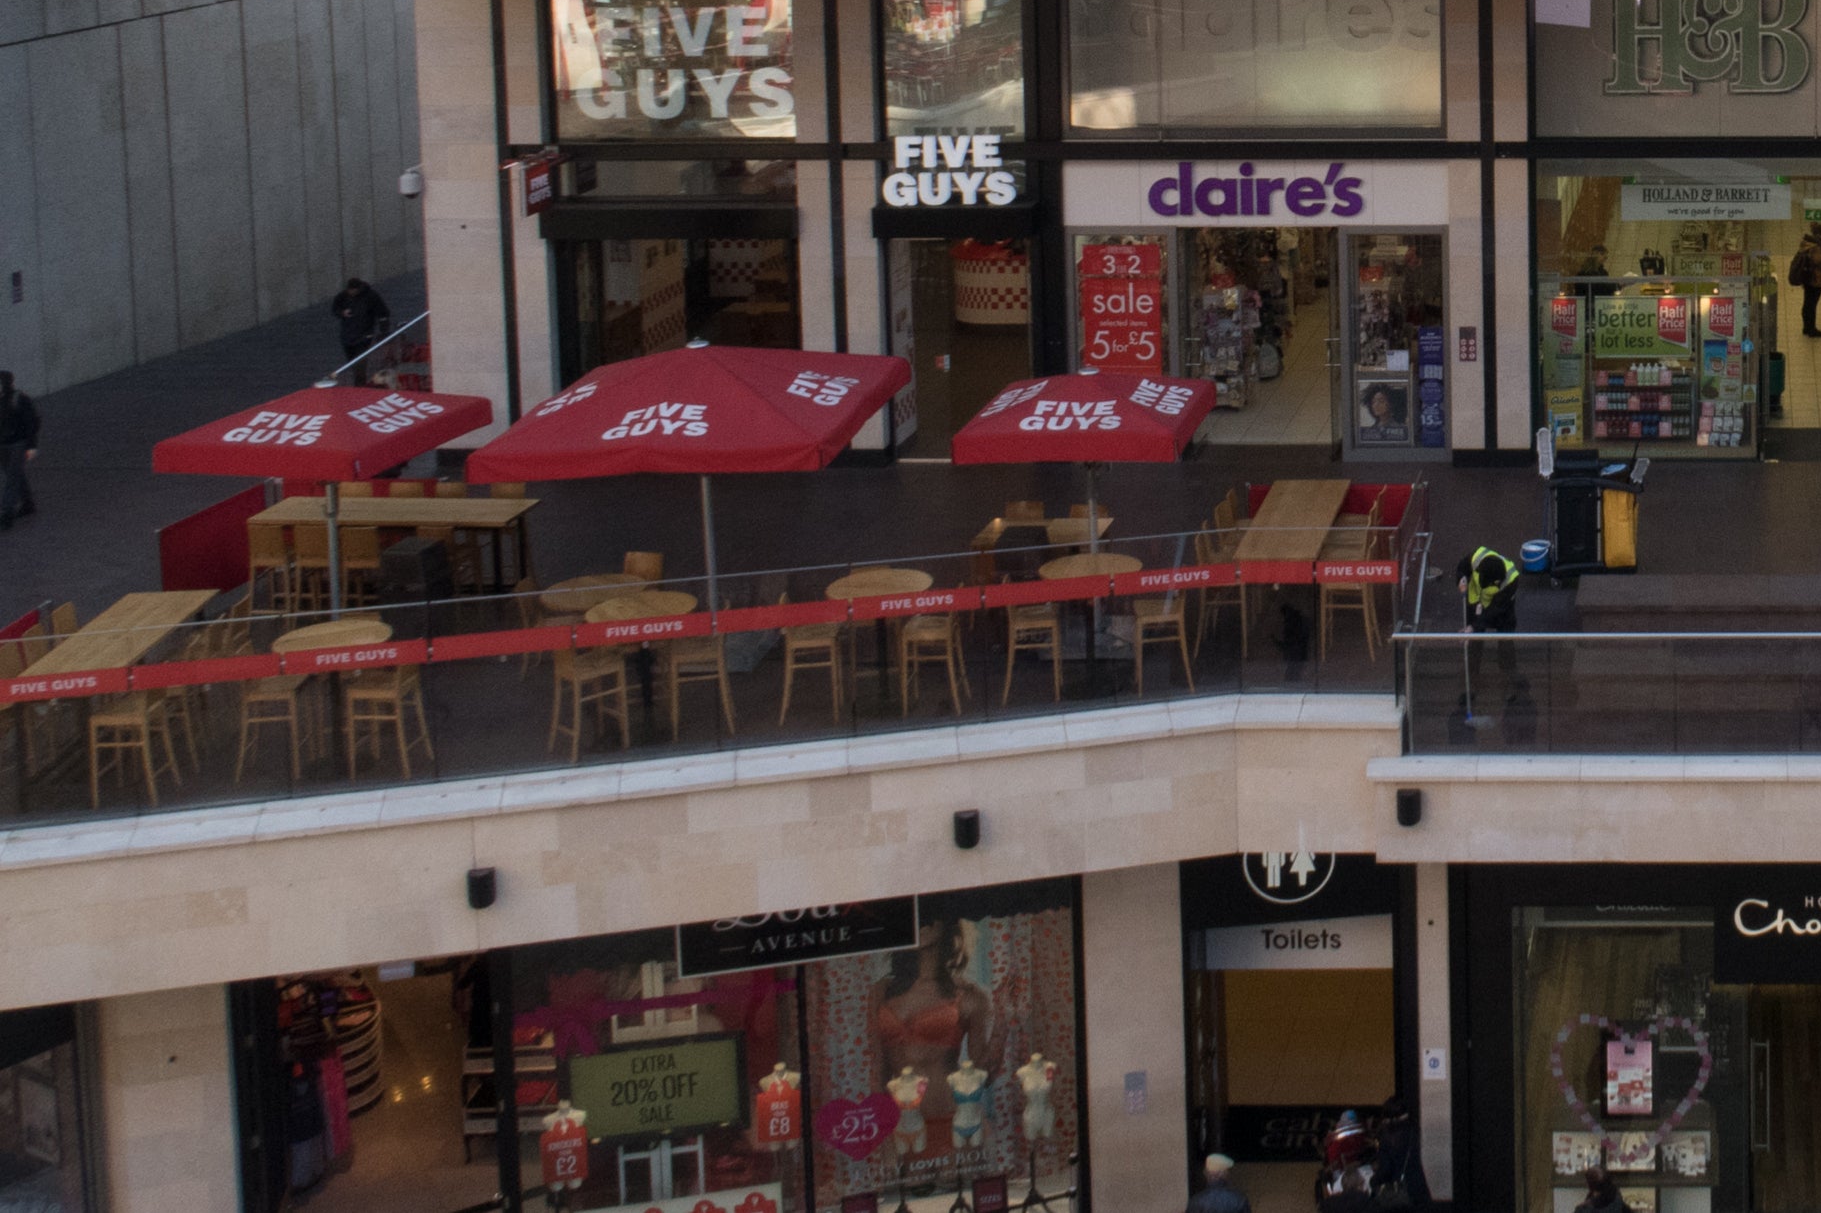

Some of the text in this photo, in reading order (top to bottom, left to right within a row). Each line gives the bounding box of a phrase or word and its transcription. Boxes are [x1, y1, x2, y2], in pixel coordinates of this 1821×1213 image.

[599, 7, 768, 57] FIVE
[576, 68, 794, 120] GUYS
[894, 135, 1003, 168] FIVE
[530, 172, 550, 190] FIVE
[882, 171, 1017, 206] GUYS
[1148, 161, 1363, 217] claire's
[528, 186, 552, 205] GUYS
[1642, 187, 1771, 202] HOLLAND & BARRETT
[1667, 206, 1745, 218] we're good for you
[1102, 255, 1141, 275] 3 2
[1680, 258, 1715, 272] better
[1723, 258, 1741, 268] Half
[1093, 282, 1153, 314] sale
[1553, 303, 1576, 315] Half
[1599, 307, 1656, 328] better
[1659, 304, 1685, 317] Half
[1710, 303, 1734, 315] Half
[1553, 315, 1576, 325] Price
[1659, 316, 1685, 329] Price
[1710, 315, 1734, 325] Price
[1090, 330, 1155, 360] 5 for £5
[1600, 333, 1654, 348] lot less
[1129, 378, 1165, 407] FIVE
[1155, 385, 1194, 415] GUYS
[348, 393, 413, 422] FIVE
[621, 402, 708, 426] FIVE
[1034, 399, 1117, 416] FIVE
[248, 411, 331, 431] FIVE
[369, 402, 444, 434] GUYS
[1019, 416, 1122, 431] GUYS
[222, 427, 322, 447] GUYS
[602, 419, 710, 441] GUYS
[1141, 571, 1210, 586] FIVE GUYS
[1324, 566, 1392, 577] FIVE GUYS
[881, 595, 954, 611] FIVE GUYS
[606, 621, 683, 639] FIVE GUYS
[316, 648, 398, 665] FIVE GUYS
[10, 676, 97, 694] FIVE GUYS
[751, 925, 853, 954] AVENUE
[1261, 929, 1342, 950] Toilets
[631, 1053, 677, 1075] EXTRA
[610, 1072, 700, 1107] 20% OFF
[639, 1104, 675, 1124] SALE
[769, 1117, 791, 1137] £8
[831, 1112, 879, 1143] £25
[555, 1155, 577, 1176] £2
[909, 1156, 949, 1171] LOVES
